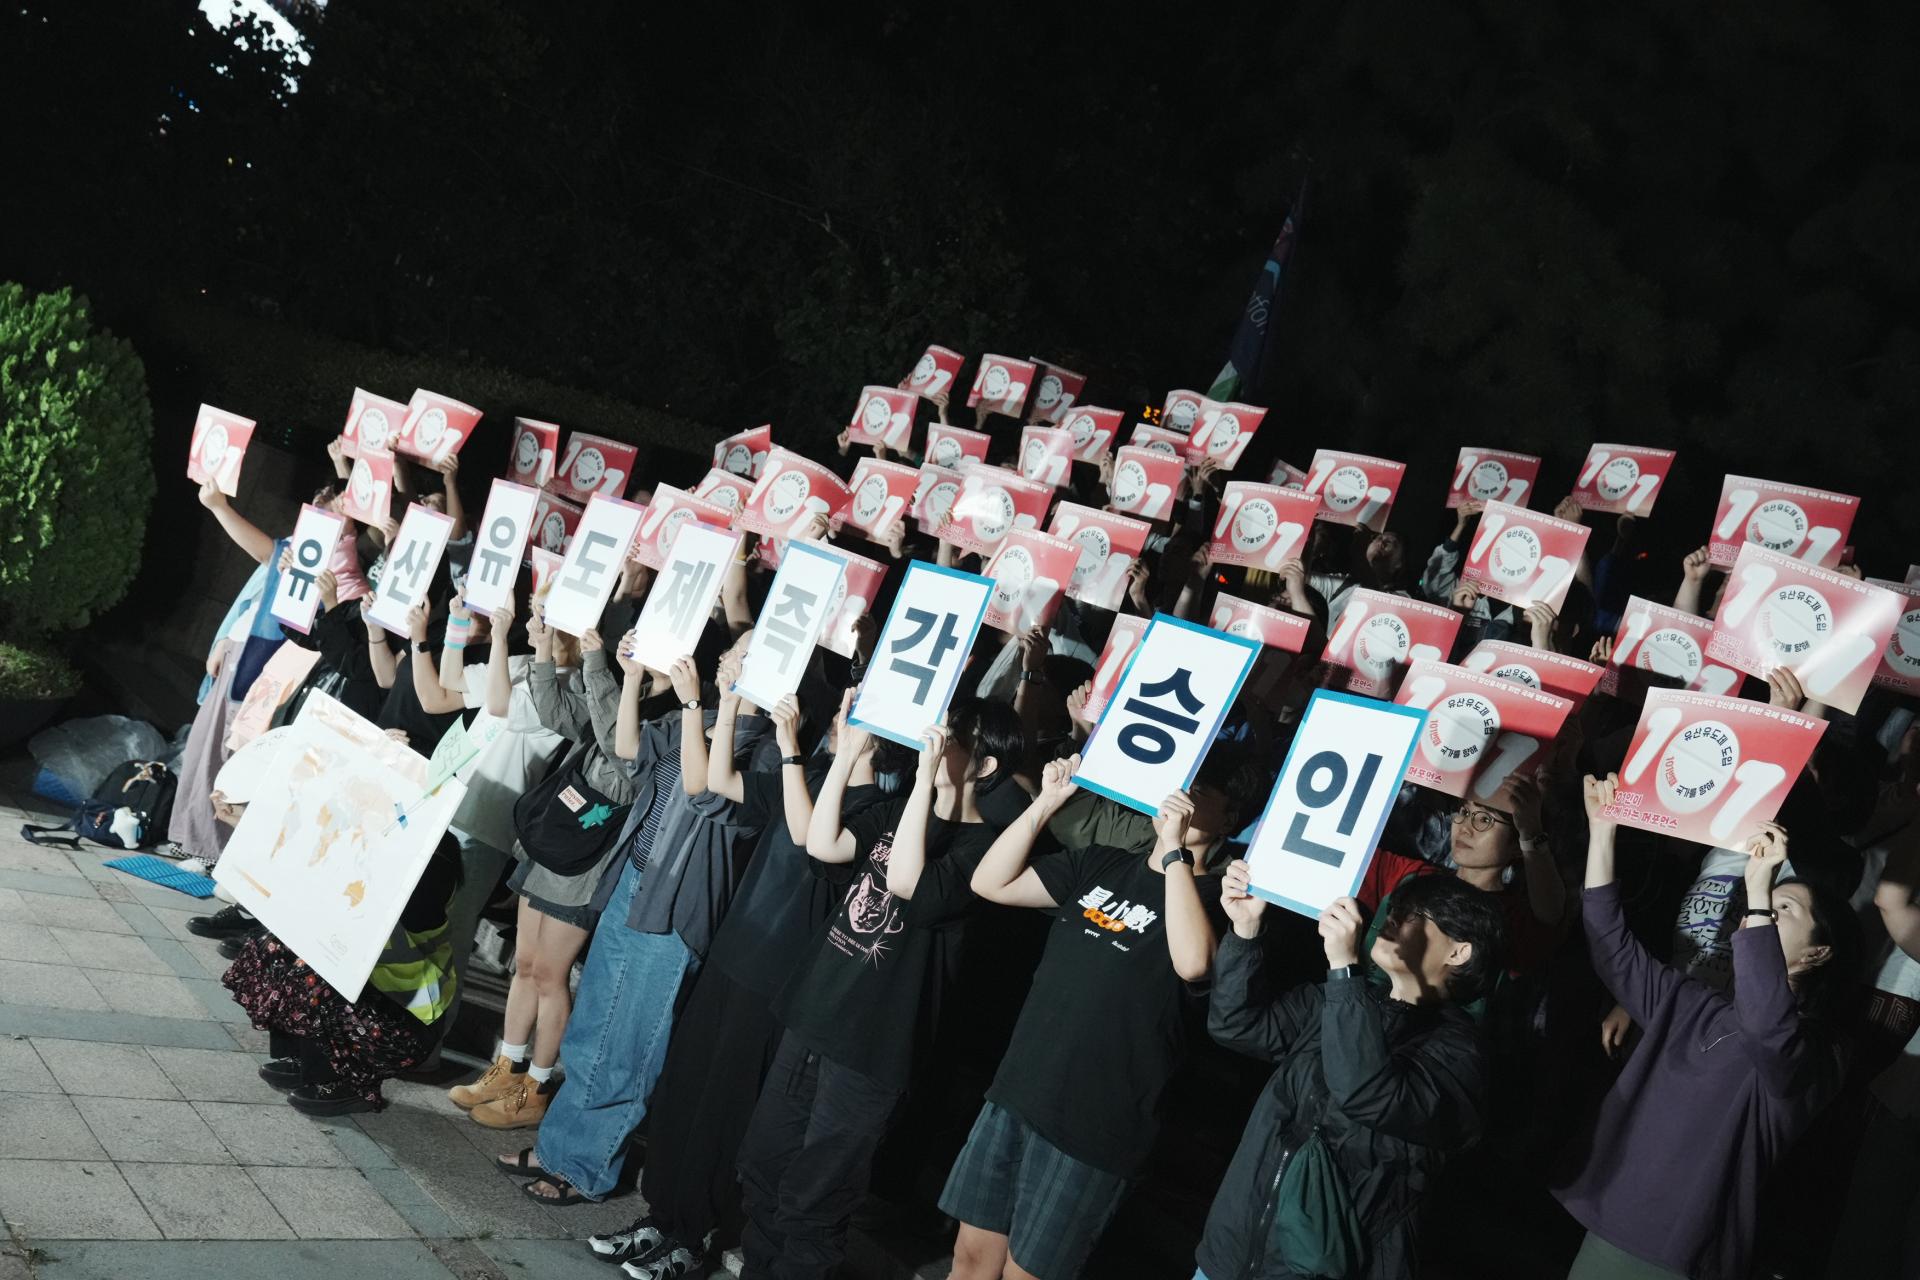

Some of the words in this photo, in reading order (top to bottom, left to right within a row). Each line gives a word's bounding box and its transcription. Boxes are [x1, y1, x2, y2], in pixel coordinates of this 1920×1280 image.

[402, 399, 463, 464] 101
[851, 393, 910, 445] 101
[1193, 410, 1253, 465] 101
[558, 441, 624, 498] 101
[747, 460, 830, 538] 101
[850, 467, 904, 538] 101
[1305, 460, 1391, 522] 101
[1453, 455, 1529, 505] 101
[1579, 452, 1660, 511] 101
[479, 516, 516, 587] 유
[1215, 492, 1304, 567] 101
[1471, 514, 1571, 602] 101
[1717, 489, 1842, 565] 101
[289, 538, 323, 602] 유
[386, 539, 433, 605] 산
[562, 530, 618, 598] 도
[654, 558, 715, 641] 제
[760, 582, 819, 676] 즉
[1723, 564, 1877, 696] 101
[1779, 590, 1822, 612] 유산유도제
[1815, 614, 1828, 633] 도입
[889, 606, 960, 707] 각
[1116, 667, 1206, 765] 승
[1405, 676, 1539, 800] 101
[1447, 697, 1491, 717] 유산유도제
[1484, 717, 1495, 735] 도입
[1684, 726, 1729, 747] 유산유도제
[1721, 746, 1733, 767] 도입
[1615, 790, 1643, 806] 01인이
[1624, 707, 1786, 840] 101
[1665, 756, 1678, 788] 101번째
[1698, 779, 1715, 797] 향해
[1281, 750, 1383, 869] 인
